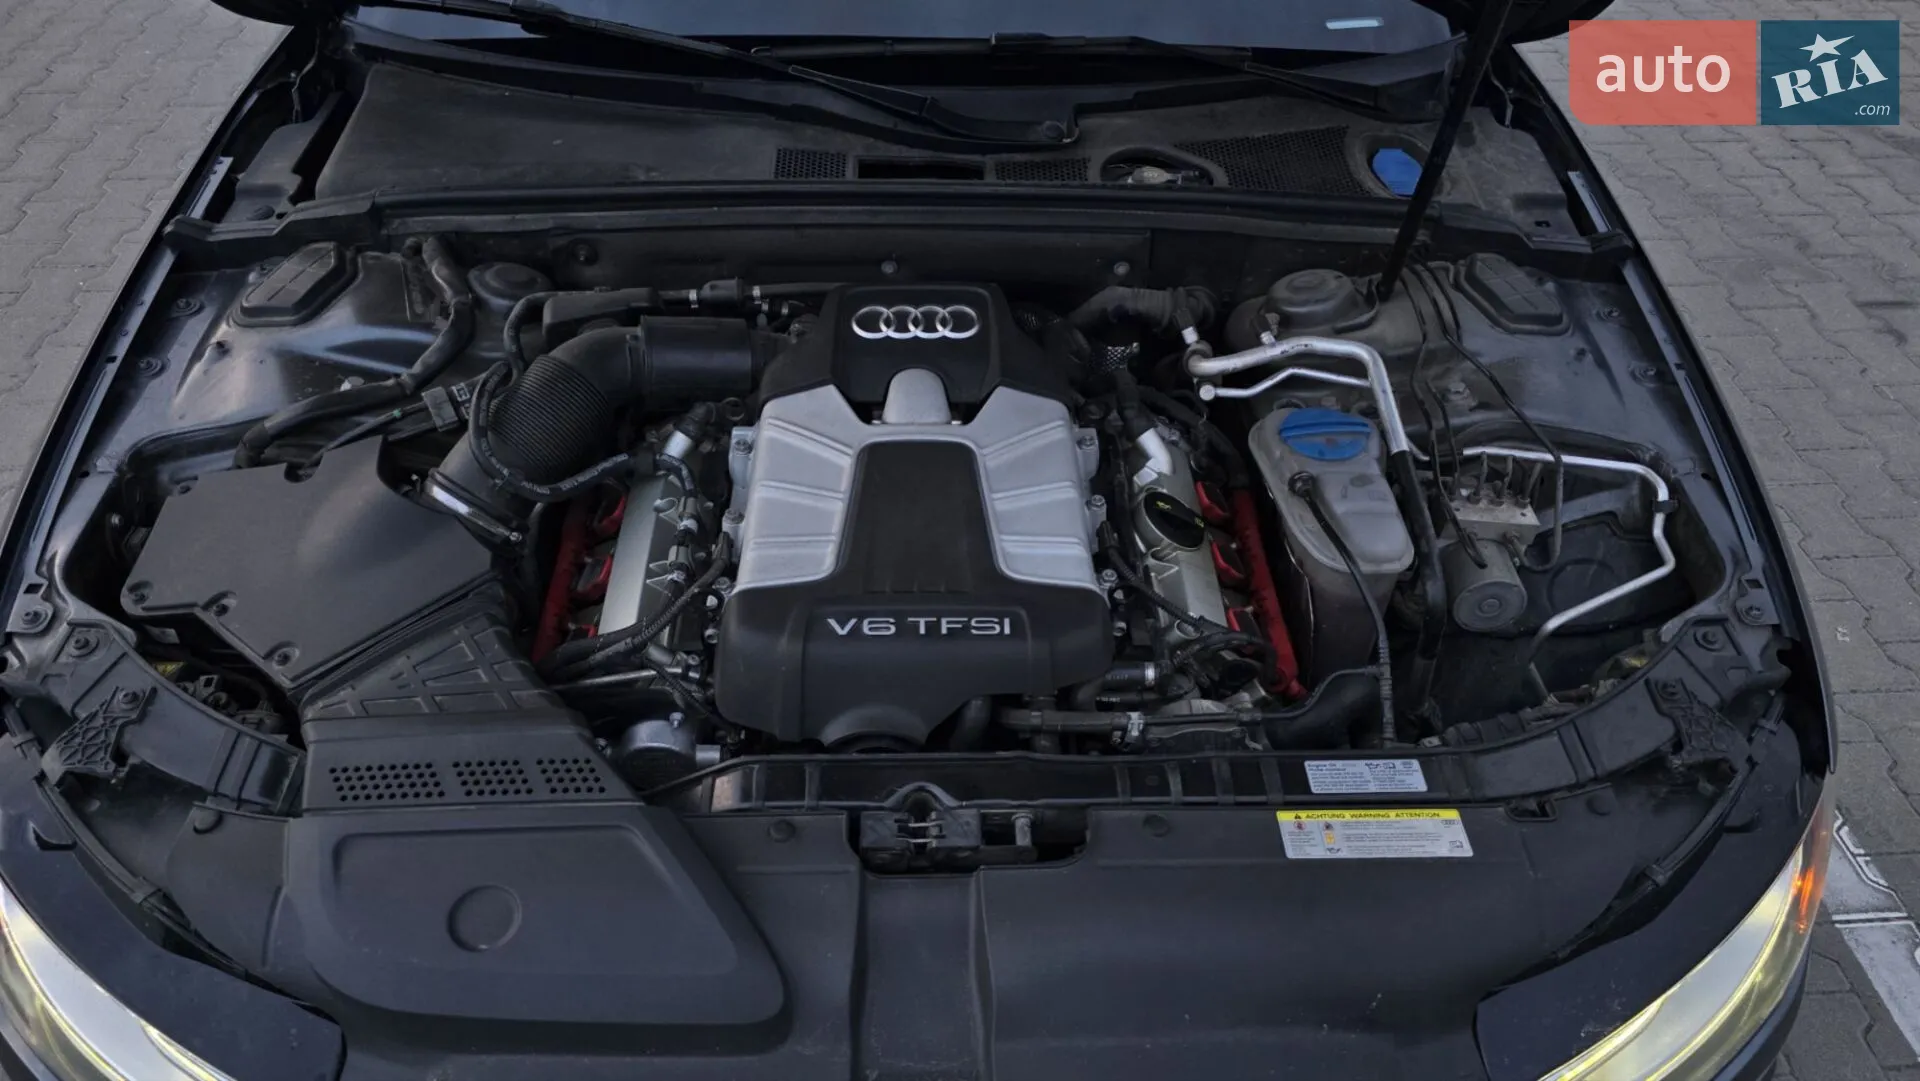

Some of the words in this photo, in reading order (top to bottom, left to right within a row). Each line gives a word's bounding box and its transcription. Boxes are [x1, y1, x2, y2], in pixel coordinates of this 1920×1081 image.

[827, 617, 897, 636] V6
[907, 617, 1011, 635] TFSI
[1394, 811, 1440, 819] ATTENTION
